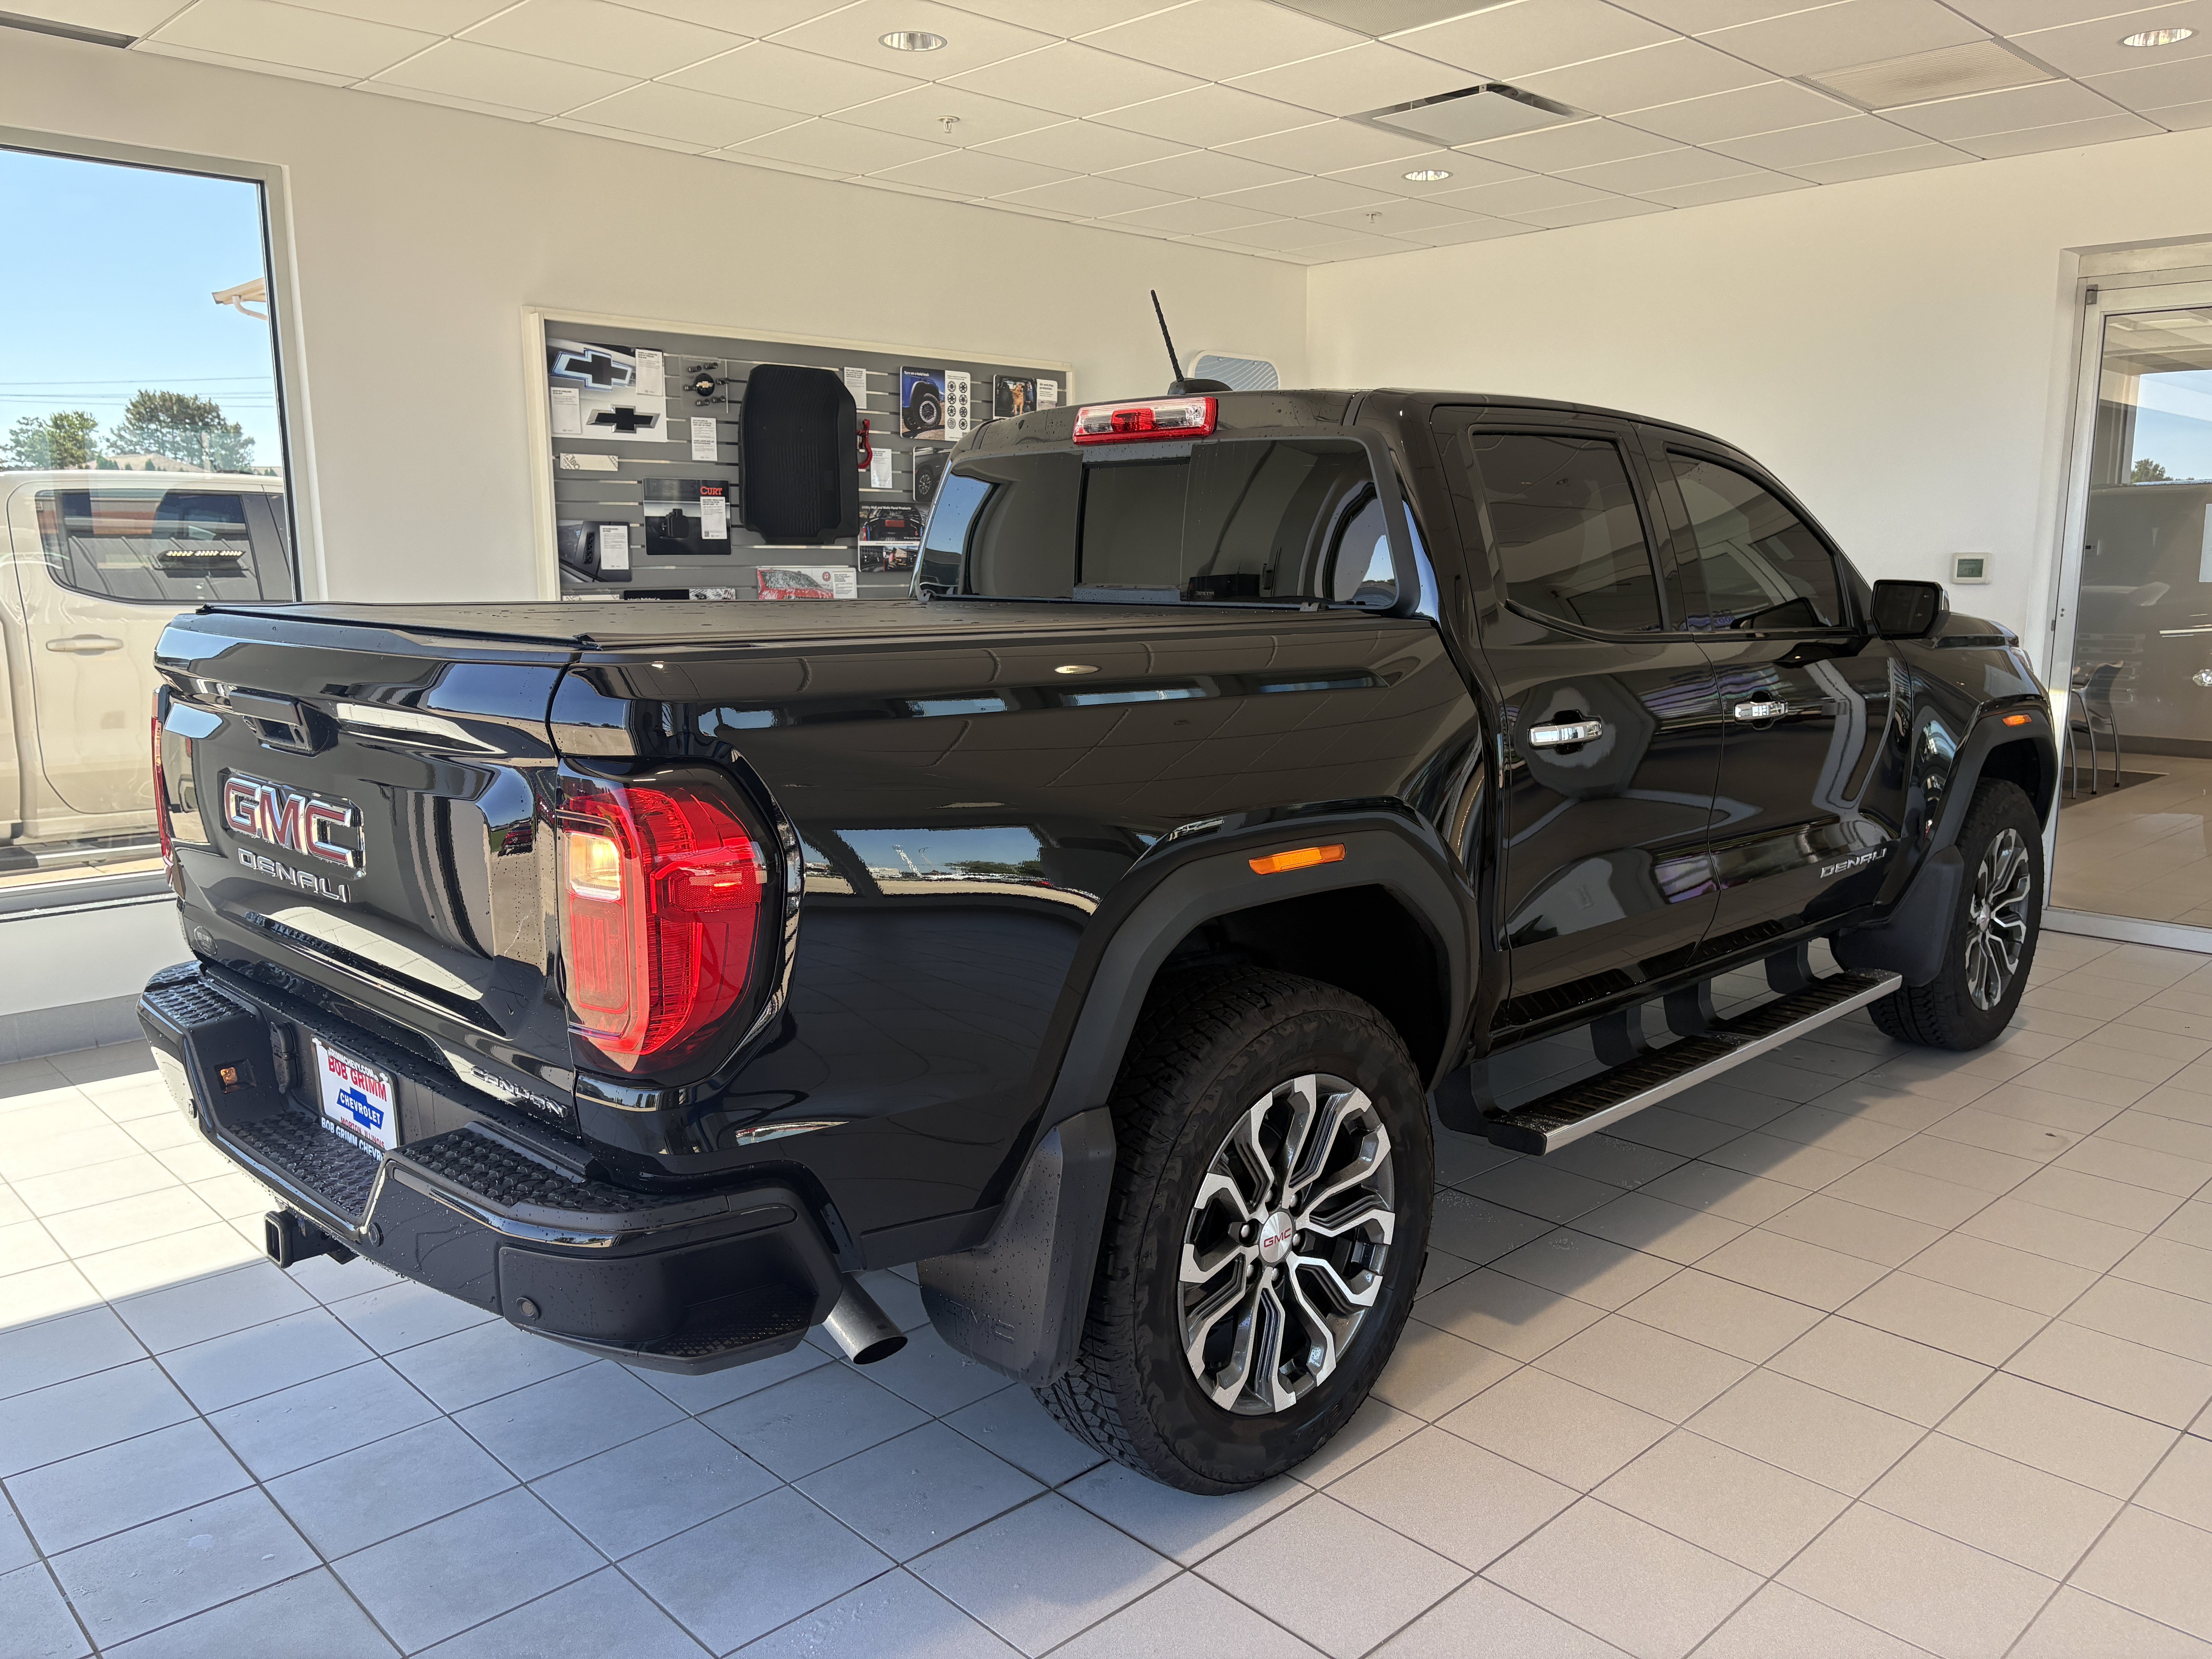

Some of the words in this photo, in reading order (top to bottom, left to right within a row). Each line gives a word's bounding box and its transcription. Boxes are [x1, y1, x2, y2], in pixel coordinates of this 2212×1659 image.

[700, 486, 723, 495] CURT
[224, 777, 356, 869] GMC
[238, 848, 351, 903] DENALI
[1820, 848, 1887, 879] DENALI
[328, 1056, 348, 1080] BOB
[350, 1068, 387, 1102] GRIMM
[470, 1066, 568, 1118] CANYON
[340, 1092, 380, 1125] CHEVROLET
[321, 1117, 335, 1134] BOB
[336, 1125, 357, 1147] GRIMM
[1264, 1227, 1291, 1248] GMC
